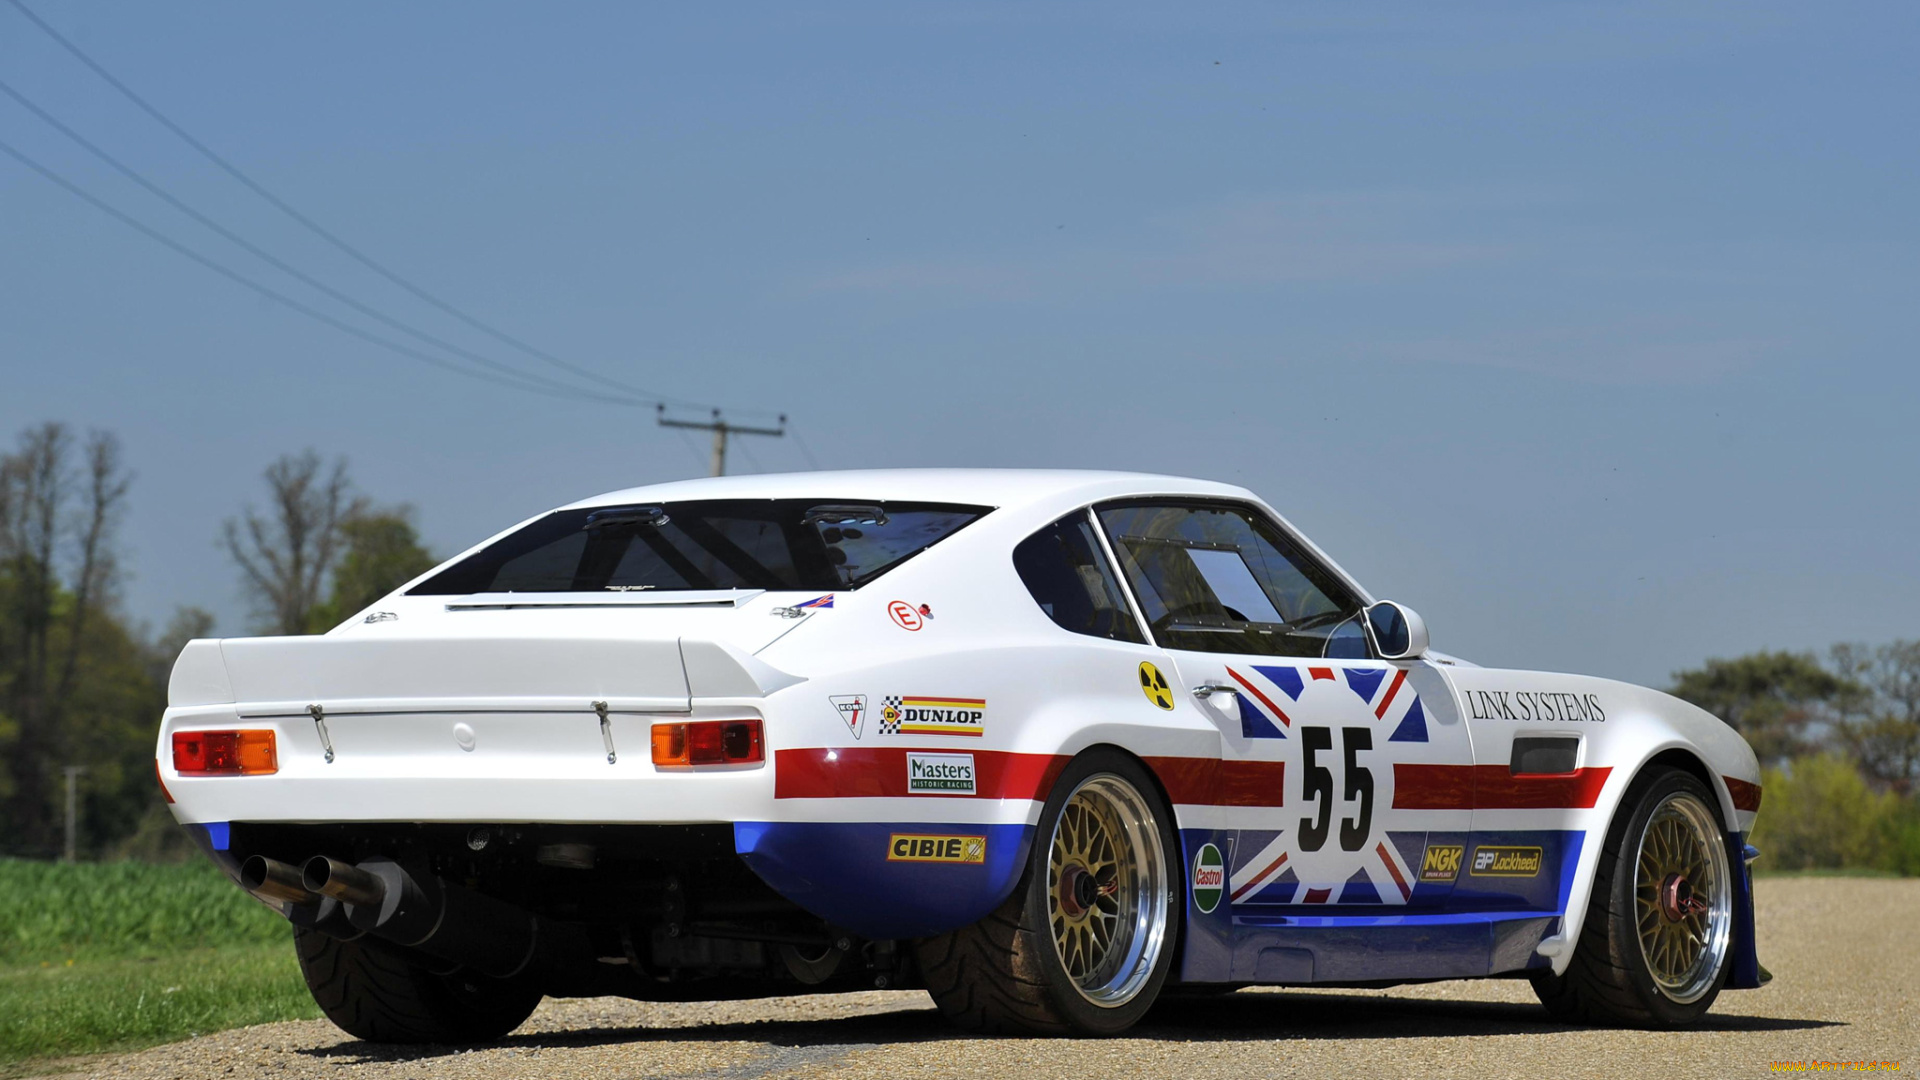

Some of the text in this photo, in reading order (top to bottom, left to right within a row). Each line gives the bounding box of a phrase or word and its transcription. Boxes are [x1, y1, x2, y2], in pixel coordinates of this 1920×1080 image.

[893, 606, 917, 625] E
[1465, 690, 1606, 722] LINK SYSTEMS
[904, 708, 983, 724] DUNLOP
[911, 759, 972, 779] Masters
[912, 780, 972, 789] HISTORIC RACING
[1298, 726, 1375, 852] 55
[1424, 848, 1462, 871] NGK
[1195, 868, 1223, 885] Castrol
